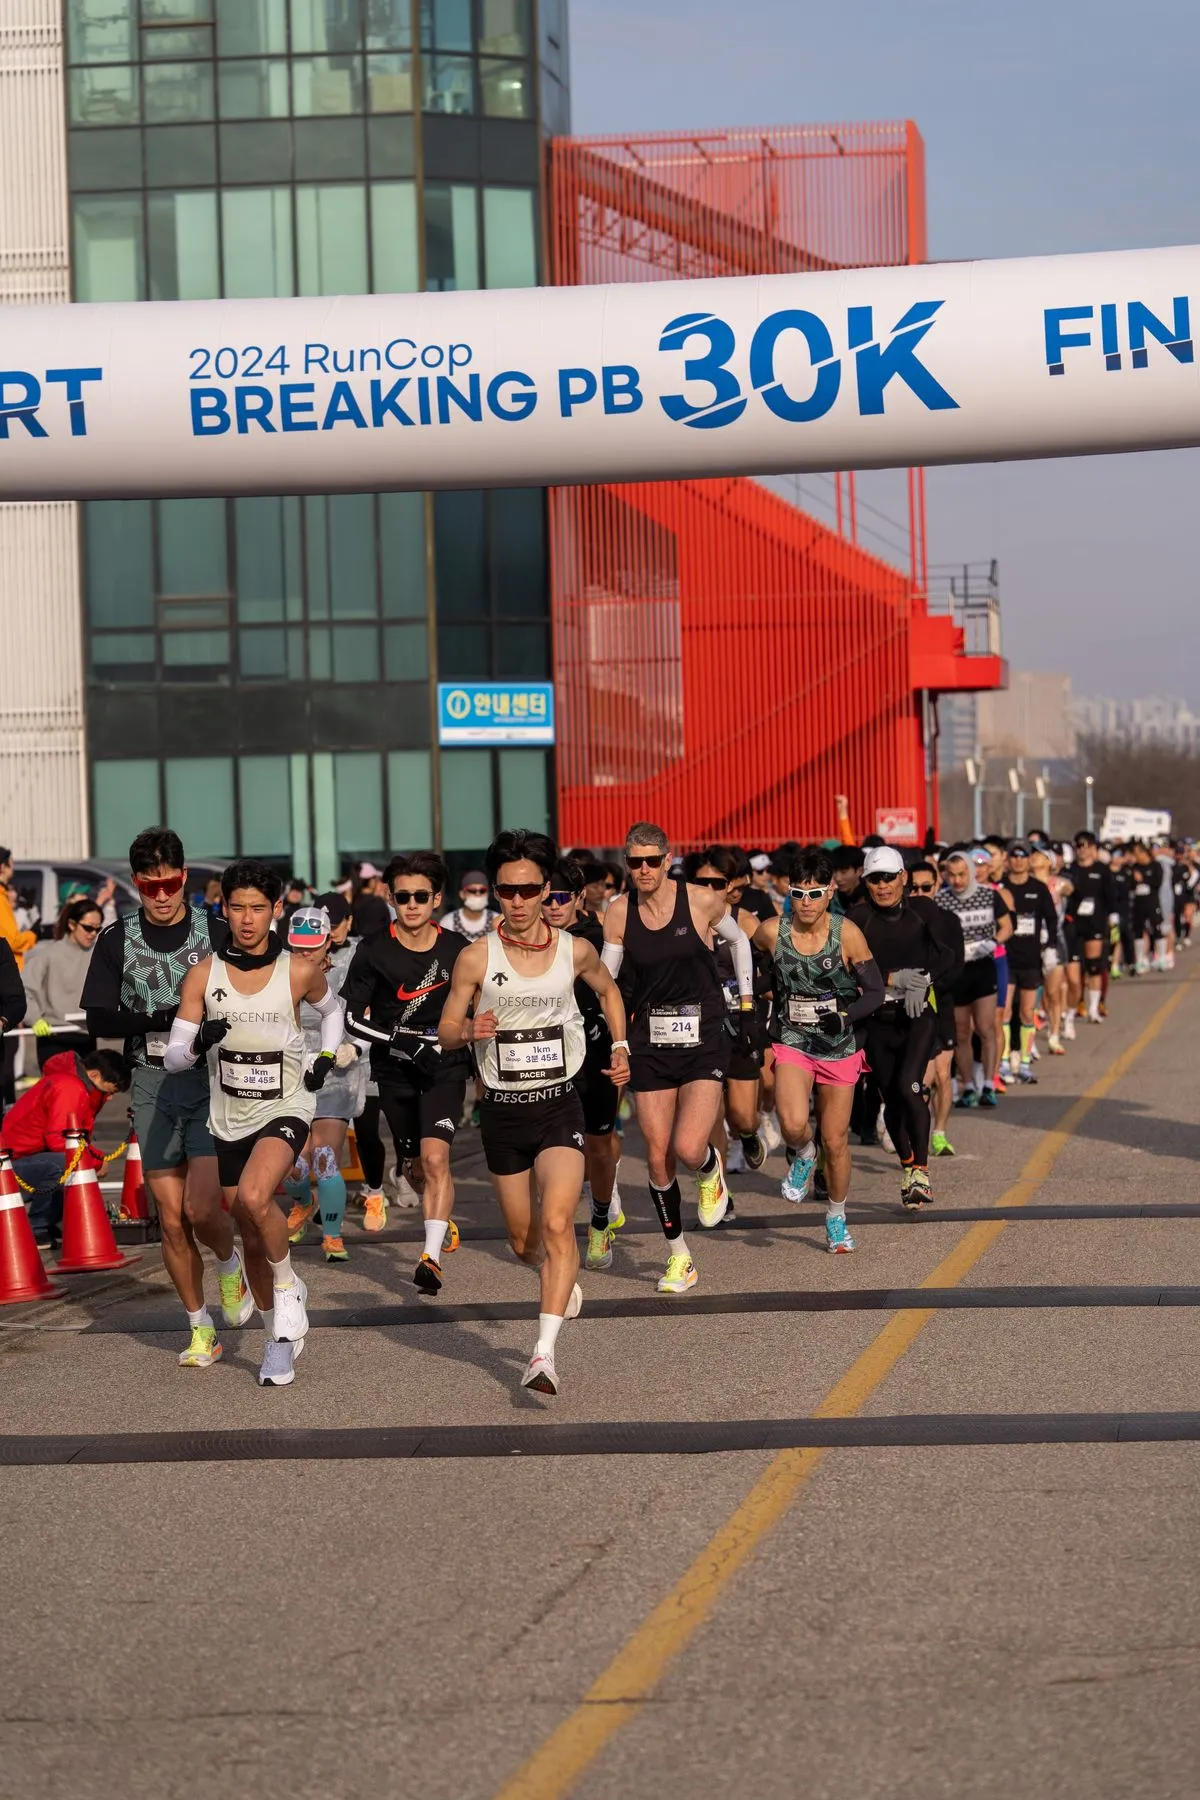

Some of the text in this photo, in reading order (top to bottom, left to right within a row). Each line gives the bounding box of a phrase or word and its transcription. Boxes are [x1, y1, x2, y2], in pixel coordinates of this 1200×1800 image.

[1044, 295, 1194, 373] FIN
[189, 338, 473, 381] 2024 RunCop
[659, 300, 960, 431] 30K
[189, 364, 645, 437] BREAKING PB
[473, 692, 546, 717] 안내센터
[498, 995, 563, 1009] DESCENTE
[216, 1011, 280, 1023] DESCENTE
[671, 1022, 692, 1032] 214
[525, 1053, 558, 1063] 3분 45초
[250, 1068, 268, 1076] 1km
[520, 1071, 546, 1079] PACER
[257, 1076, 275, 1084] 45초
[237, 1090, 262, 1098] PACER
[494, 1086, 562, 1104] DESCENTE
